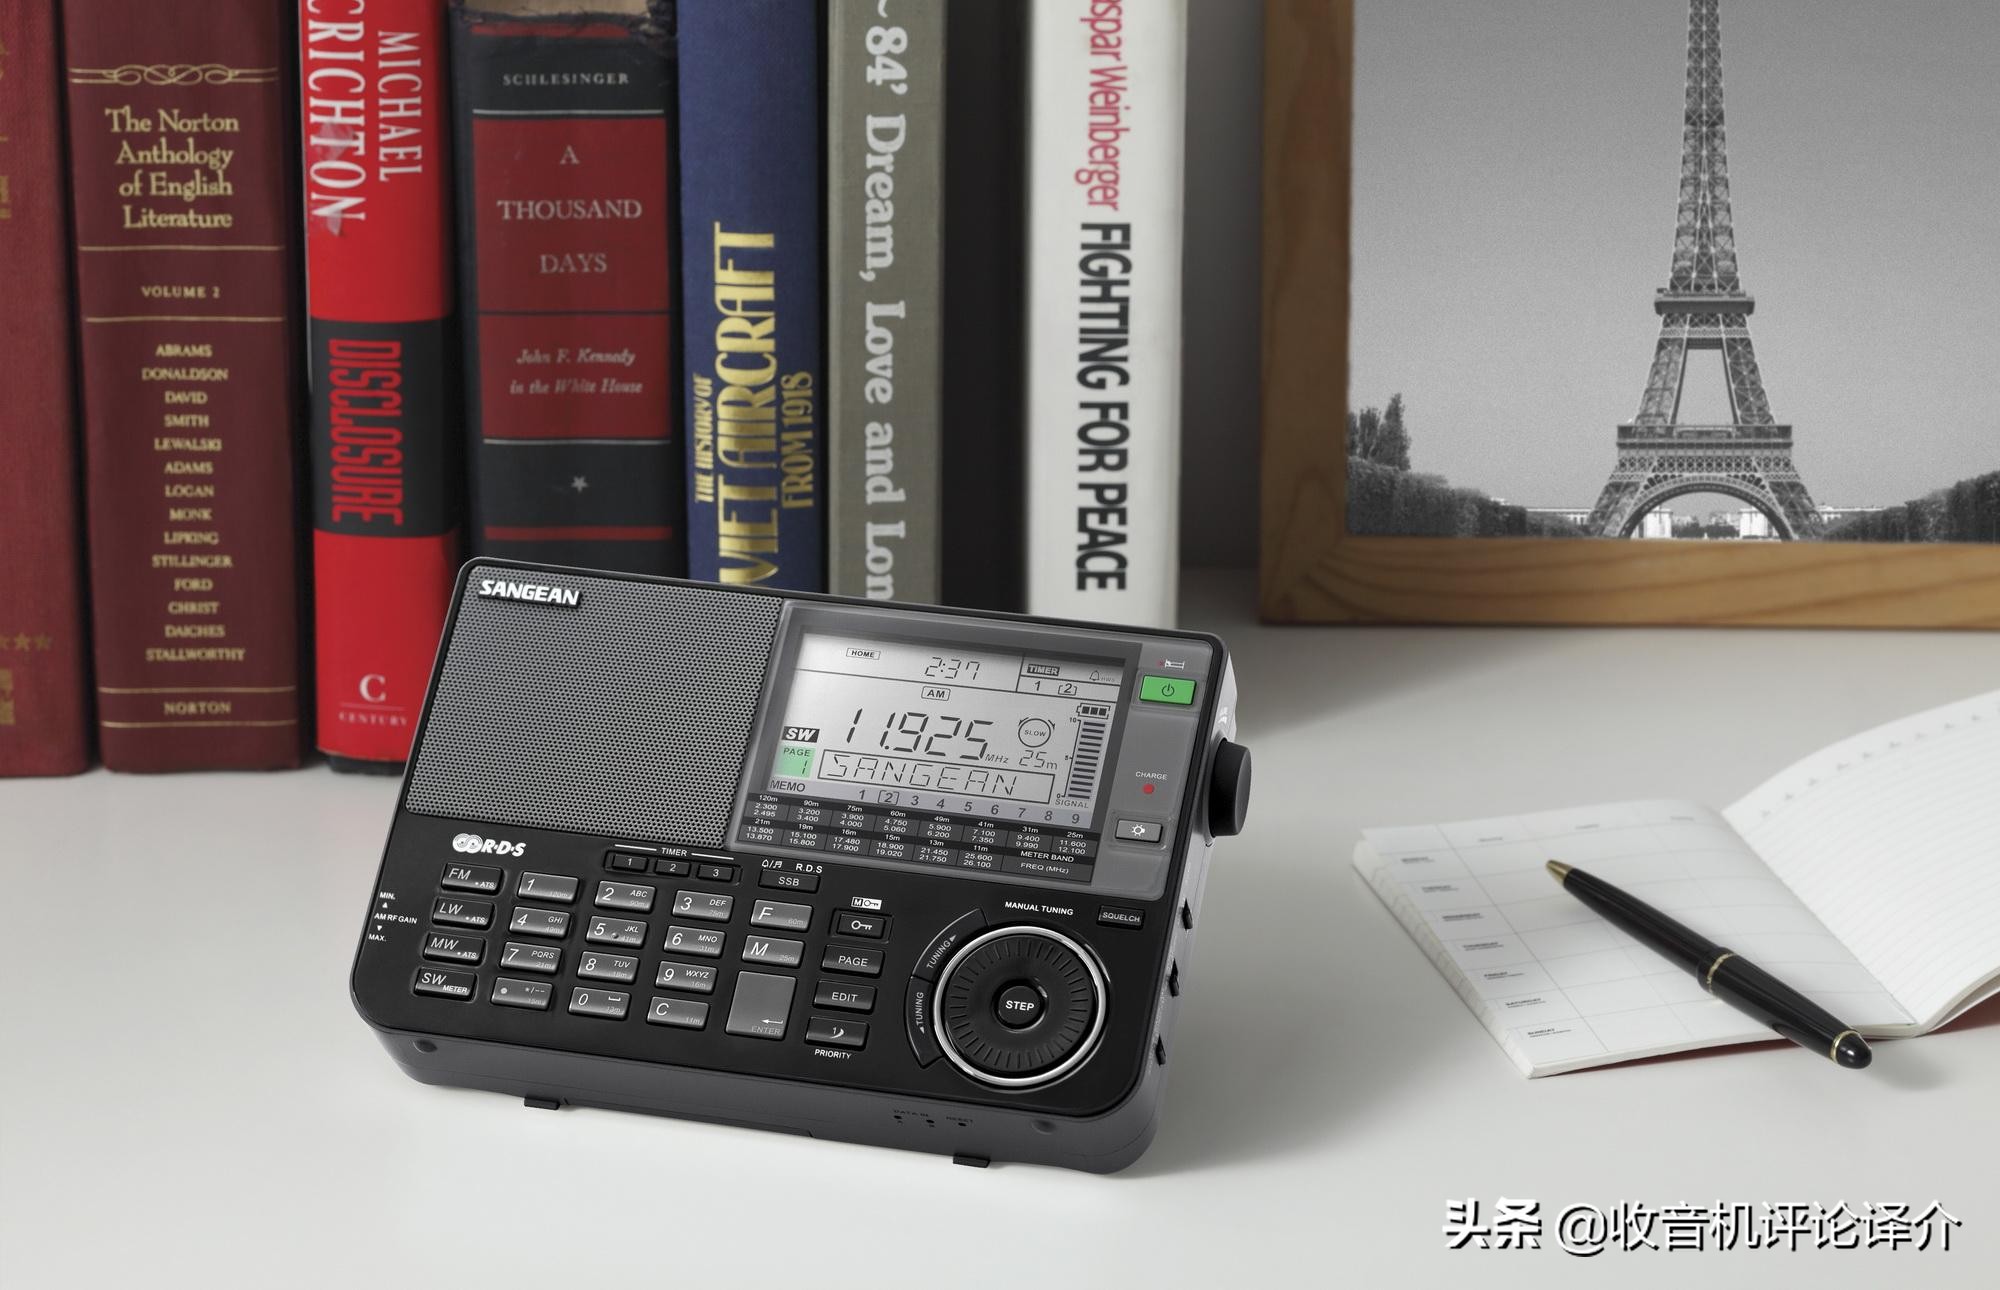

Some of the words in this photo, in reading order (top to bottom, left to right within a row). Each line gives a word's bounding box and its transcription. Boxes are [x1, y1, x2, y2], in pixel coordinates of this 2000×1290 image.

[503, 73, 630, 86] SCHLESINGER
[377, 30, 423, 182] MICHAEL
[105, 105, 152, 132] The
[158, 109, 240, 132] Norton
[1074, 66, 1131, 212] Weinberger
[115, 137, 234, 171] Anthology
[559, 145, 580, 165] A
[118, 170, 144, 197] of
[149, 169, 233, 202] English
[859, 114, 907, 282] Dream,
[497, 199, 644, 221] THOUSAND
[122, 205, 233, 229] Literature
[539, 252, 608, 275] DAYS
[141, 286, 206, 298] VOLUME
[212, 286, 221, 298] 2
[1076, 222, 1133, 391] FIGHTING
[155, 344, 213, 357] ABRAMS
[713, 220, 779, 468] AIRCRAFT
[516, 350, 551, 365] John
[557, 350, 572, 364] F.
[577, 349, 636, 367] Kennedy
[865, 301, 906, 404] Love
[142, 368, 229, 381] DONALDSON
[510, 379, 524, 395] in
[529, 378, 550, 395] the
[555, 378, 597, 395] White
[601, 378, 643, 395] House
[165, 391, 208, 404] DAVID
[780, 371, 814, 427] 1918
[164, 415, 209, 428] SMITH
[328, 338, 404, 526] DISCLOSURE
[1076, 401, 1132, 472] FOR
[164, 462, 214, 475] ADAMS
[781, 430, 814, 509] FROM
[865, 422, 906, 505] and
[165, 485, 214, 498] LOGAN
[169, 508, 213, 521] MONK
[1076, 482, 1129, 592] PEACE
[174, 579, 213, 592] FORD
[479, 579, 580, 606] SANGEAN
[168, 602, 219, 615] CHRIST
[165, 625, 225, 638] DAICHES
[146, 648, 246, 661] STALLWORTHY
[851, 649, 875, 658] HOME
[924, 656, 981, 681] 2:37
[1028, 663, 1060, 677] TIMER
[359, 674, 387, 702] C
[927, 689, 946, 699] AM
[164, 702, 232, 715] NORTON
[338, 712, 408, 727] CENTURY
[785, 728, 816, 741] SW
[846, 708, 994, 760] 11.925
[985, 753, 1010, 765] MHz
[1024, 729, 1048, 738] SLOW
[784, 747, 811, 757] PAGE
[1018, 750, 1058, 770] 25m
[827, 754, 1017, 795] SANGEAN
[1135, 771, 1168, 781] CHARGE
[769, 780, 806, 793] MEMO
[884, 793, 893, 803] 2
[911, 796, 919, 806] 3
[936, 799, 945, 809] 4
[964, 802, 973, 812] 5
[991, 804, 999, 815] 6
[1018, 808, 1026, 818] 7
[1045, 811, 1053, 821] 8
[1072, 814, 1080, 824] 9
[1055, 800, 1089, 809] SIGNAL
[890, 810, 906, 818] 60m
[1066, 831, 1084, 839] 25m
[973, 829, 996, 837] 7.100
[1017, 834, 1040, 843] 9.400
[798, 823, 814, 831] 19m
[929, 839, 945, 847] 13m
[1020, 851, 1050, 859] METER
[1050, 854, 1075, 863] BAND
[661, 847, 688, 857] TIMER
[449, 868, 472, 880] FM
[669, 863, 677, 872] 2
[712, 868, 719, 877] 3
[795, 863, 823, 873] R.D.S
[1020, 862, 1044, 871] FREQ
[1046, 866, 1070, 875] (MHz)
[480, 881, 495, 889] ATS
[527, 879, 536, 892] 1
[778, 876, 800, 886] SSB
[379, 891, 396, 900] MIN.
[602, 887, 615, 901] 2
[630, 889, 648, 898] ABC
[439, 902, 464, 915] LW
[680, 896, 693, 911] 3
[709, 899, 727, 907] DEF
[1004, 901, 1041, 913] MANUAL
[1041, 905, 1074, 916] TUNING
[374, 913, 387, 921] AM
[398, 915, 418, 925] GAIN
[470, 916, 486, 924] ATS
[517, 913, 528, 926] 4
[548, 916, 563, 924] GHI
[758, 907, 774, 921] F
[1102, 911, 1141, 923] SQUELCH
[594, 922, 607, 936] 5
[624, 925, 639, 933] JKL
[368, 933, 386, 942] MAX.
[431, 937, 459, 950] MW
[672, 932, 683, 946] 6
[697, 934, 718, 943] MNO
[462, 951, 477, 959] ATS
[507, 948, 520, 961] 7
[531, 950, 555, 959] PQRS
[750, 941, 769, 956] M
[926, 940, 951, 970] TUNING
[585, 958, 597, 971] 8
[613, 960, 631, 968] TUV
[838, 955, 869, 967] PAGE
[421, 972, 446, 986] SW
[663, 968, 675, 982] 9
[685, 969, 709, 979] WXYZ
[443, 985, 468, 994] METER
[578, 993, 589, 1006] 0
[831, 991, 859, 1002] EDIT
[655, 1002, 670, 1016] C
[915, 991, 925, 1026] TUNING
[1005, 1000, 1035, 1011] STEP
[751, 1025, 781, 1035] ENTER
[814, 1048, 852, 1059] PRIORITY
